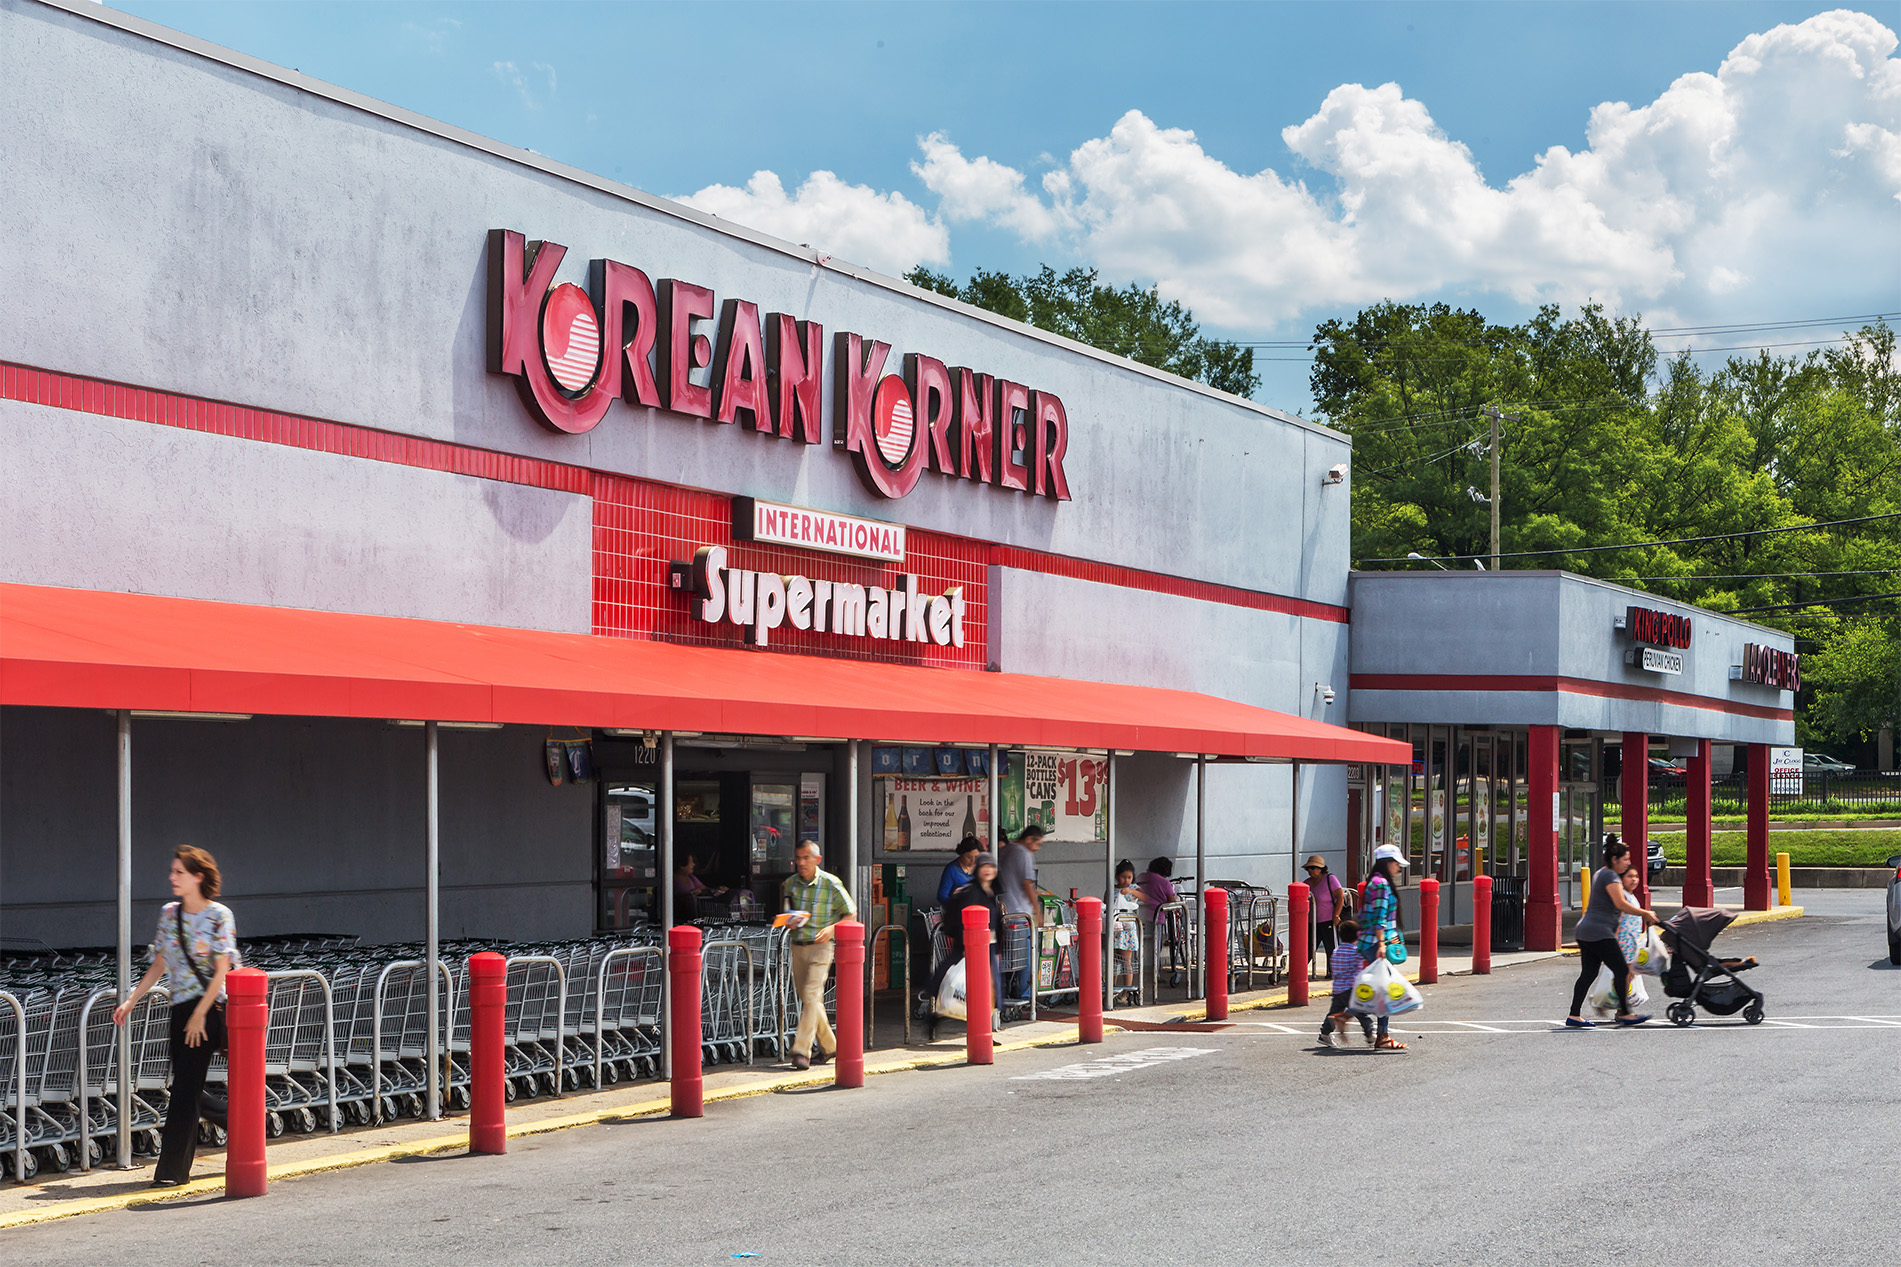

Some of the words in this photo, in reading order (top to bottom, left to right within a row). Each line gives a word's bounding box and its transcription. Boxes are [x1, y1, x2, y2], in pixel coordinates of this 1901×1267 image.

[501, 229, 823, 443] KOREAN
[847, 332, 1072, 501] KORNER
[758, 507, 901, 556] INTERNATIONAL
[702, 546, 965, 649] Supermarket
[1633, 607, 1659, 643] KING
[1661, 612, 1691, 649] POLLO
[1664, 655, 1682, 672] CHICKEN
[1026, 755, 1057, 769] 12-PACK
[1026, 769, 1057, 782] BOTTLES
[894, 778, 927, 792] BEER
[931, 780, 941, 792] &
[945, 779, 981, 793] WINE
[1030, 782, 1057, 800] CANS
[919, 798, 934, 806] Look
[943, 798, 954, 806] the
[918, 808, 933, 816] back
[934, 808, 943, 816] for
[922, 819, 950, 828] improved
[920, 829, 952, 838] selections!
